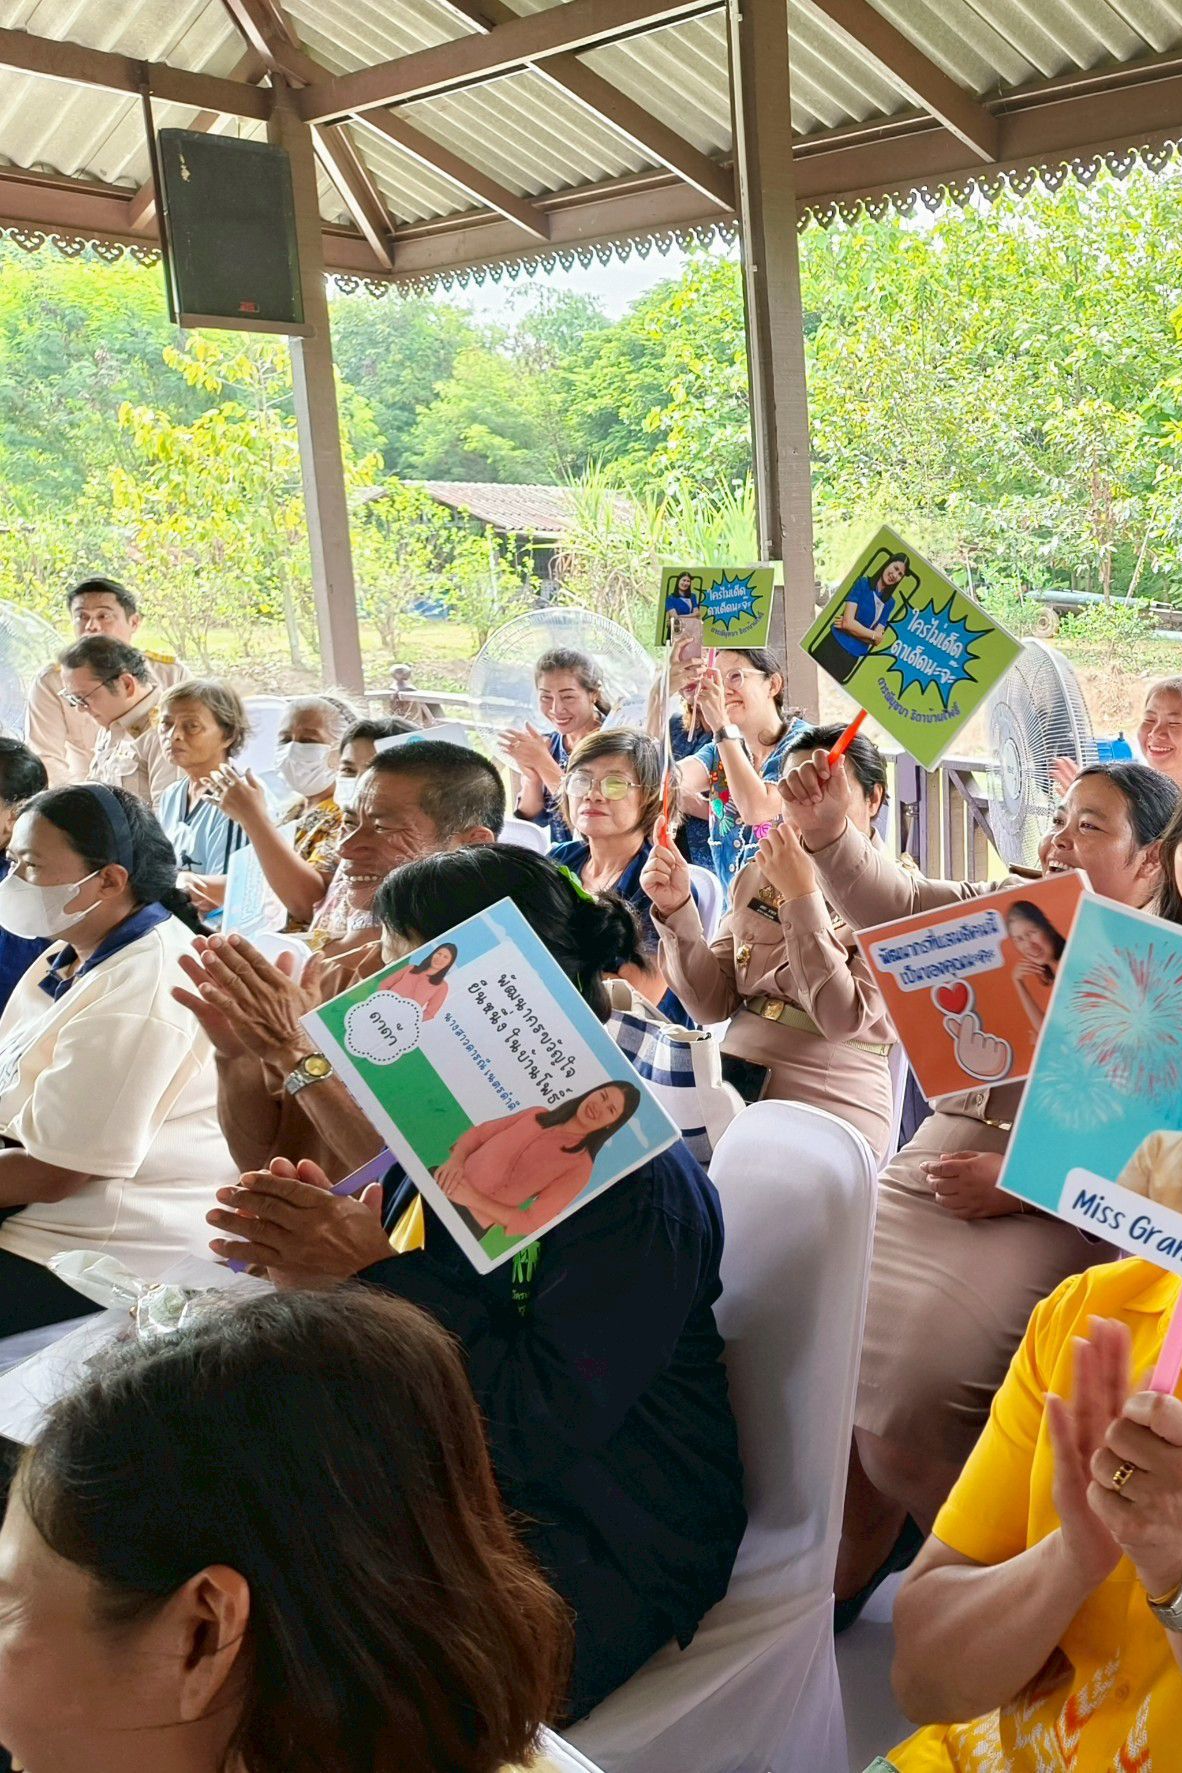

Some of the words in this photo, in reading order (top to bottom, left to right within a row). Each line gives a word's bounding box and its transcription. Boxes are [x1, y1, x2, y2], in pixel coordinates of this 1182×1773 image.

[707, 583, 746, 601] ใครไม่เด็ด
[908, 608, 962, 659] ใครไม่เด็ด
[443, 1011, 491, 1071] นางสาวดารณี
[497, 973, 576, 1078] พัฒนากรขวัญใจ
[1072, 1189, 1126, 1230] Miss
